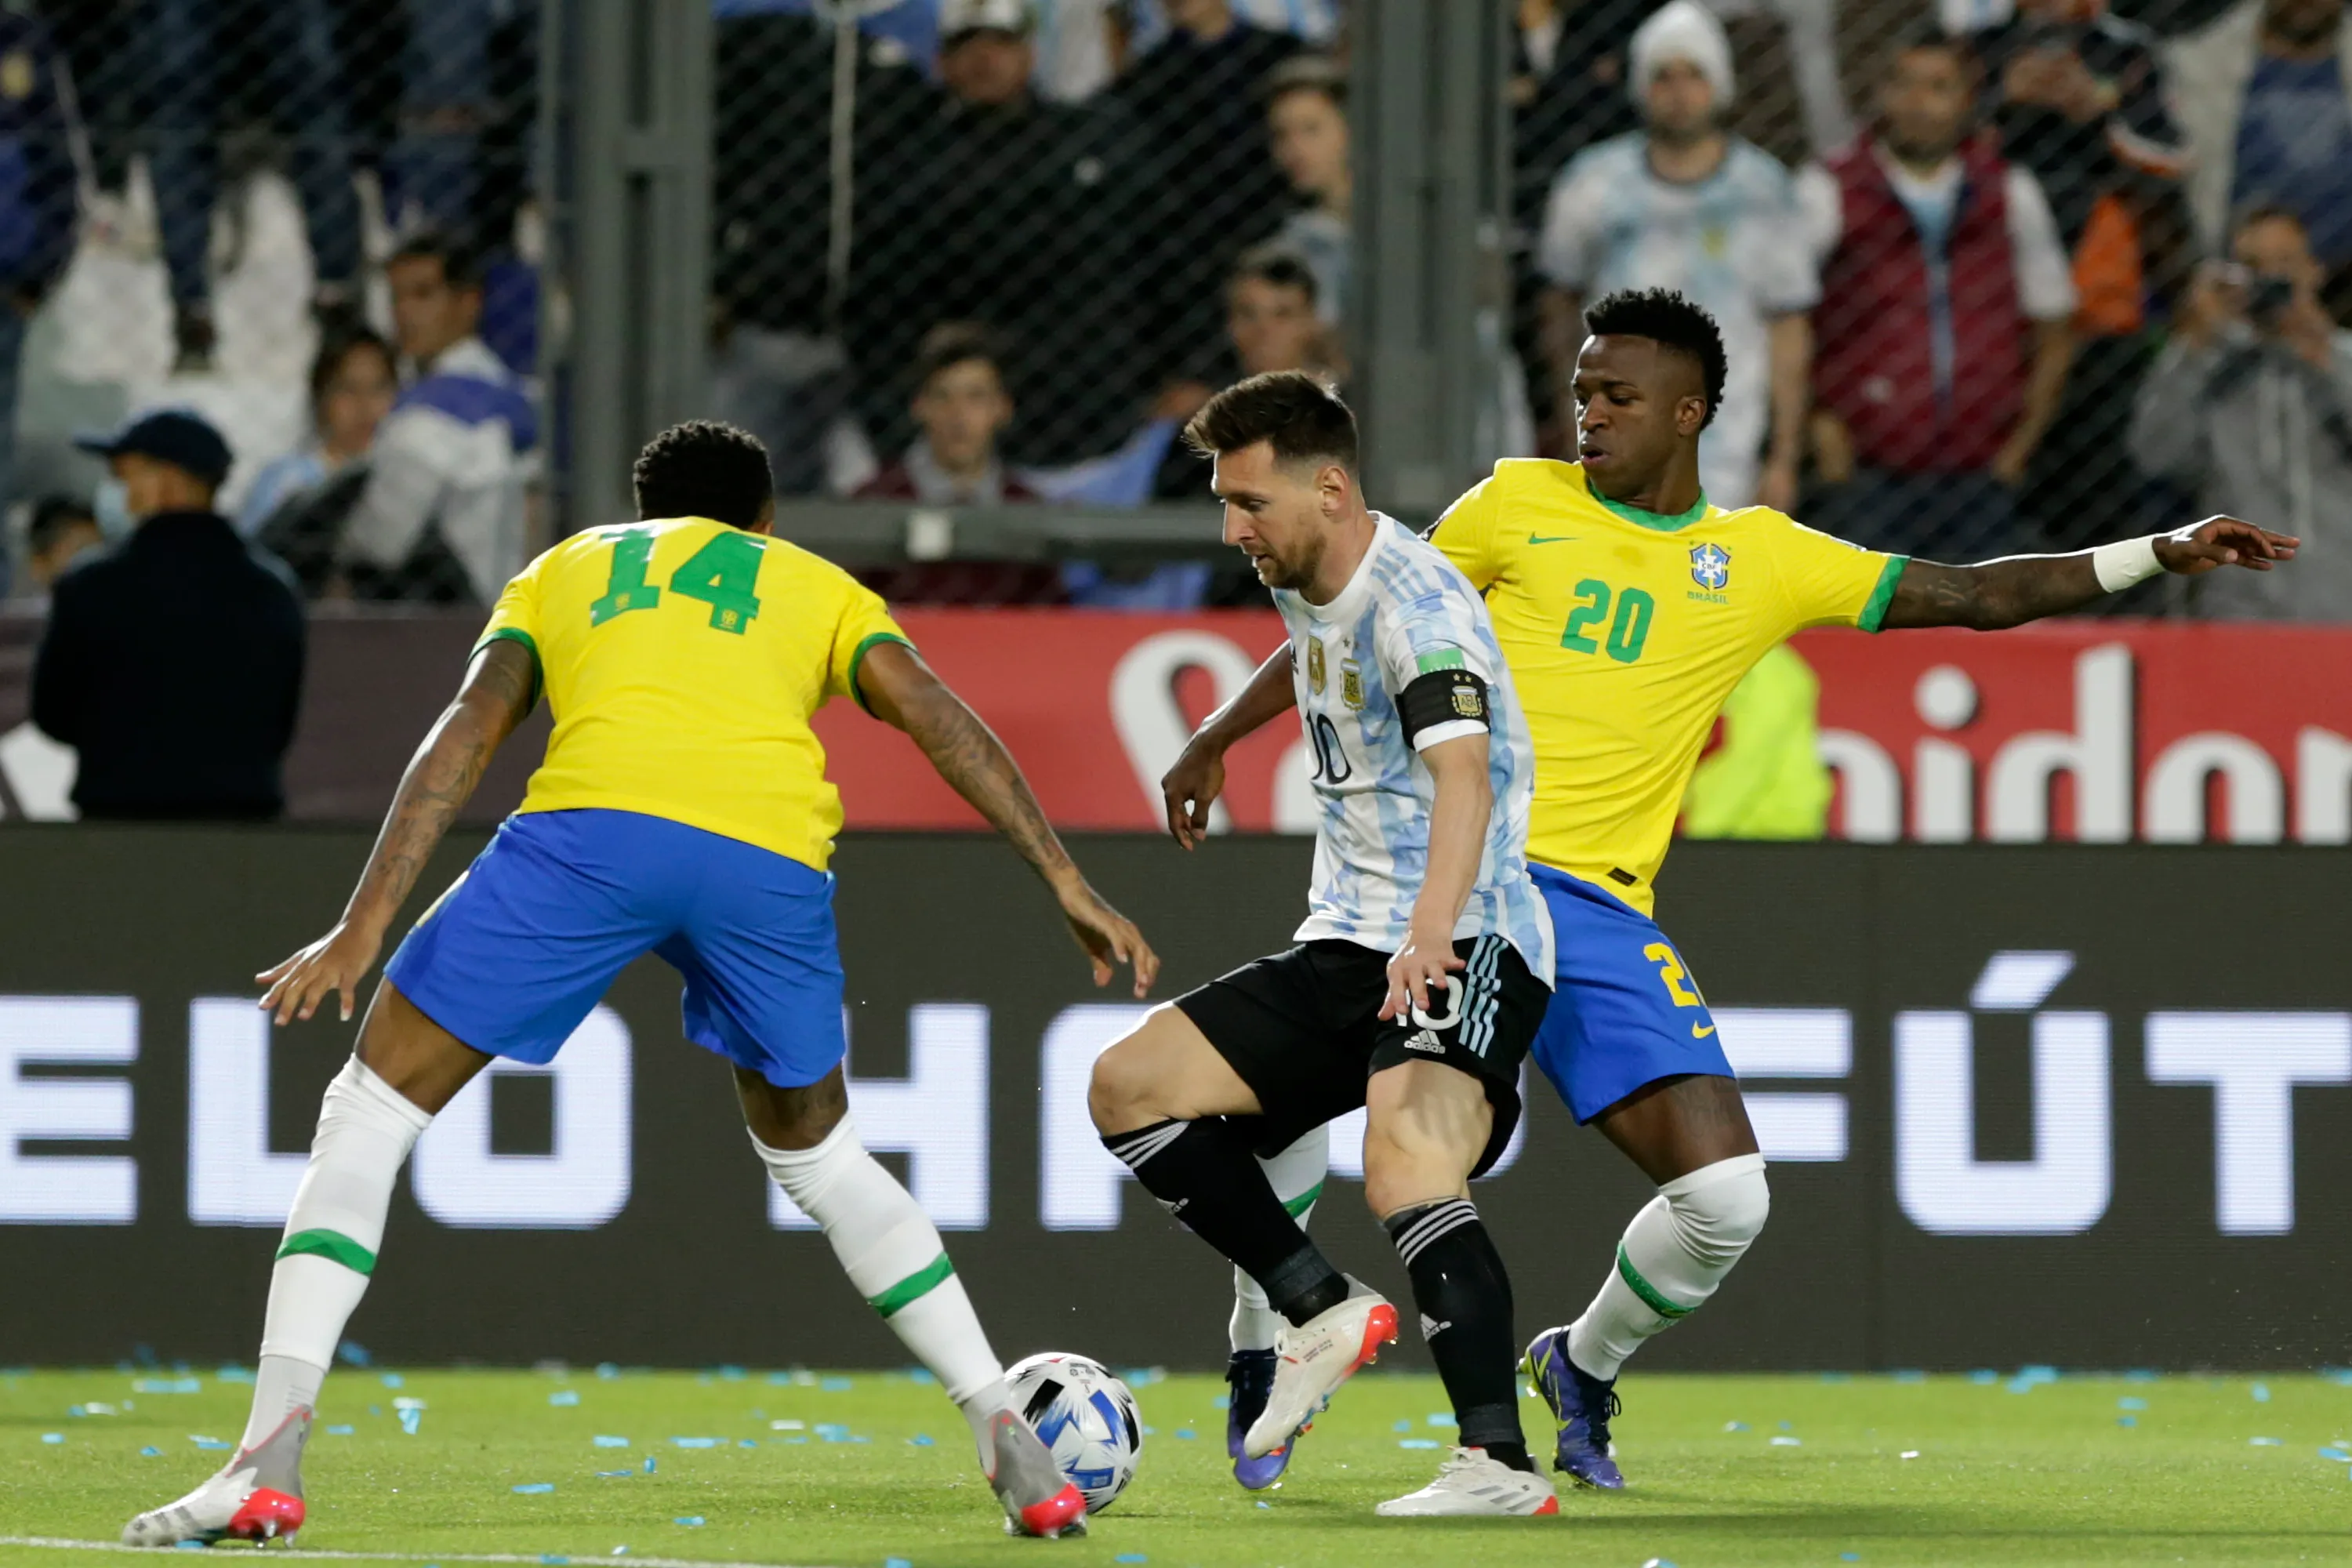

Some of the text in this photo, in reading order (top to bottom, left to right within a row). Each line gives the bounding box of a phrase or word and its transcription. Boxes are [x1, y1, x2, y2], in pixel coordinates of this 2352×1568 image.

[590, 528, 768, 635] 14
[1560, 579, 1655, 663] 20
[1686, 590, 1730, 605] BRASIL
[1305, 709, 1352, 785] 10
[0, 996, 632, 1229] ELO
